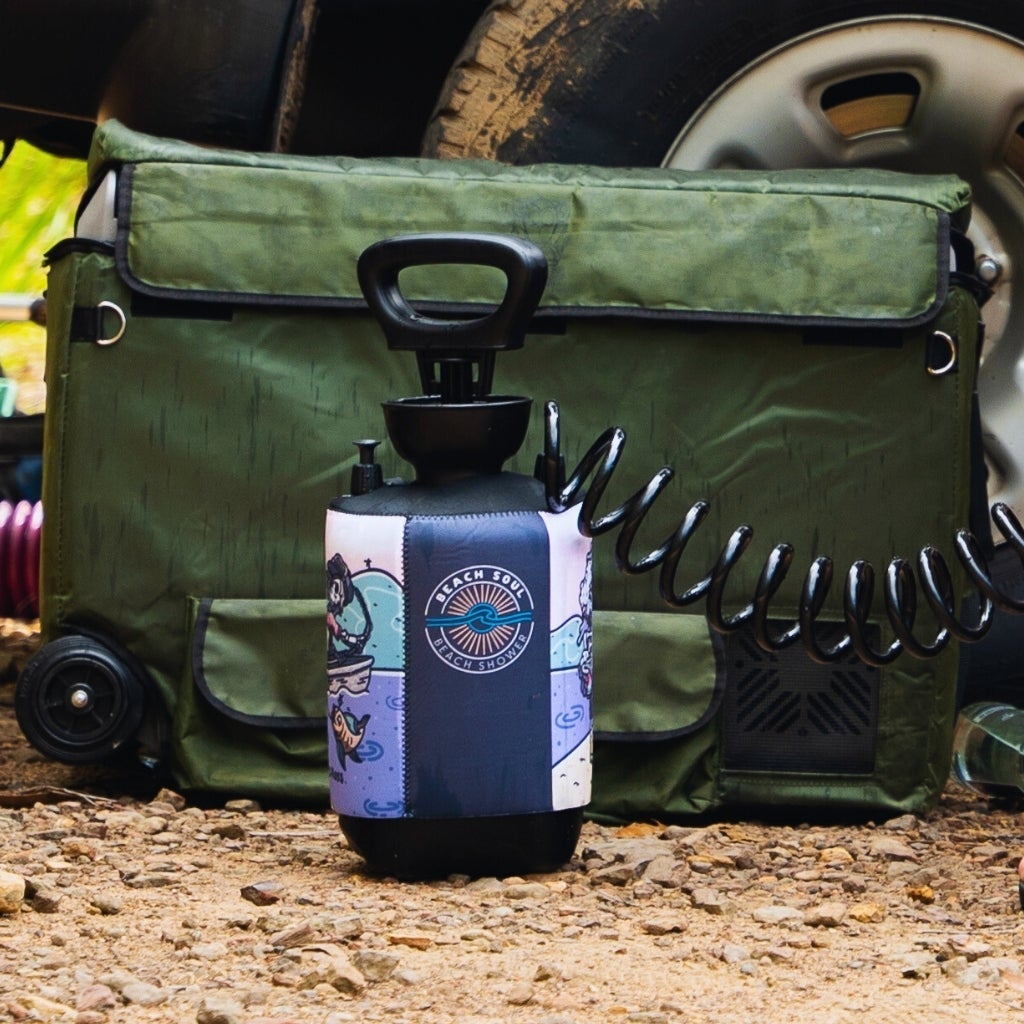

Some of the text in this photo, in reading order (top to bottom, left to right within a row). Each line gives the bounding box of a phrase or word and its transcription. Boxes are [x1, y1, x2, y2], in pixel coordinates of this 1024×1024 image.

[435, 570, 525, 603] BEACH SOUL
[433, 634, 527, 671] BEACH SHOWER
